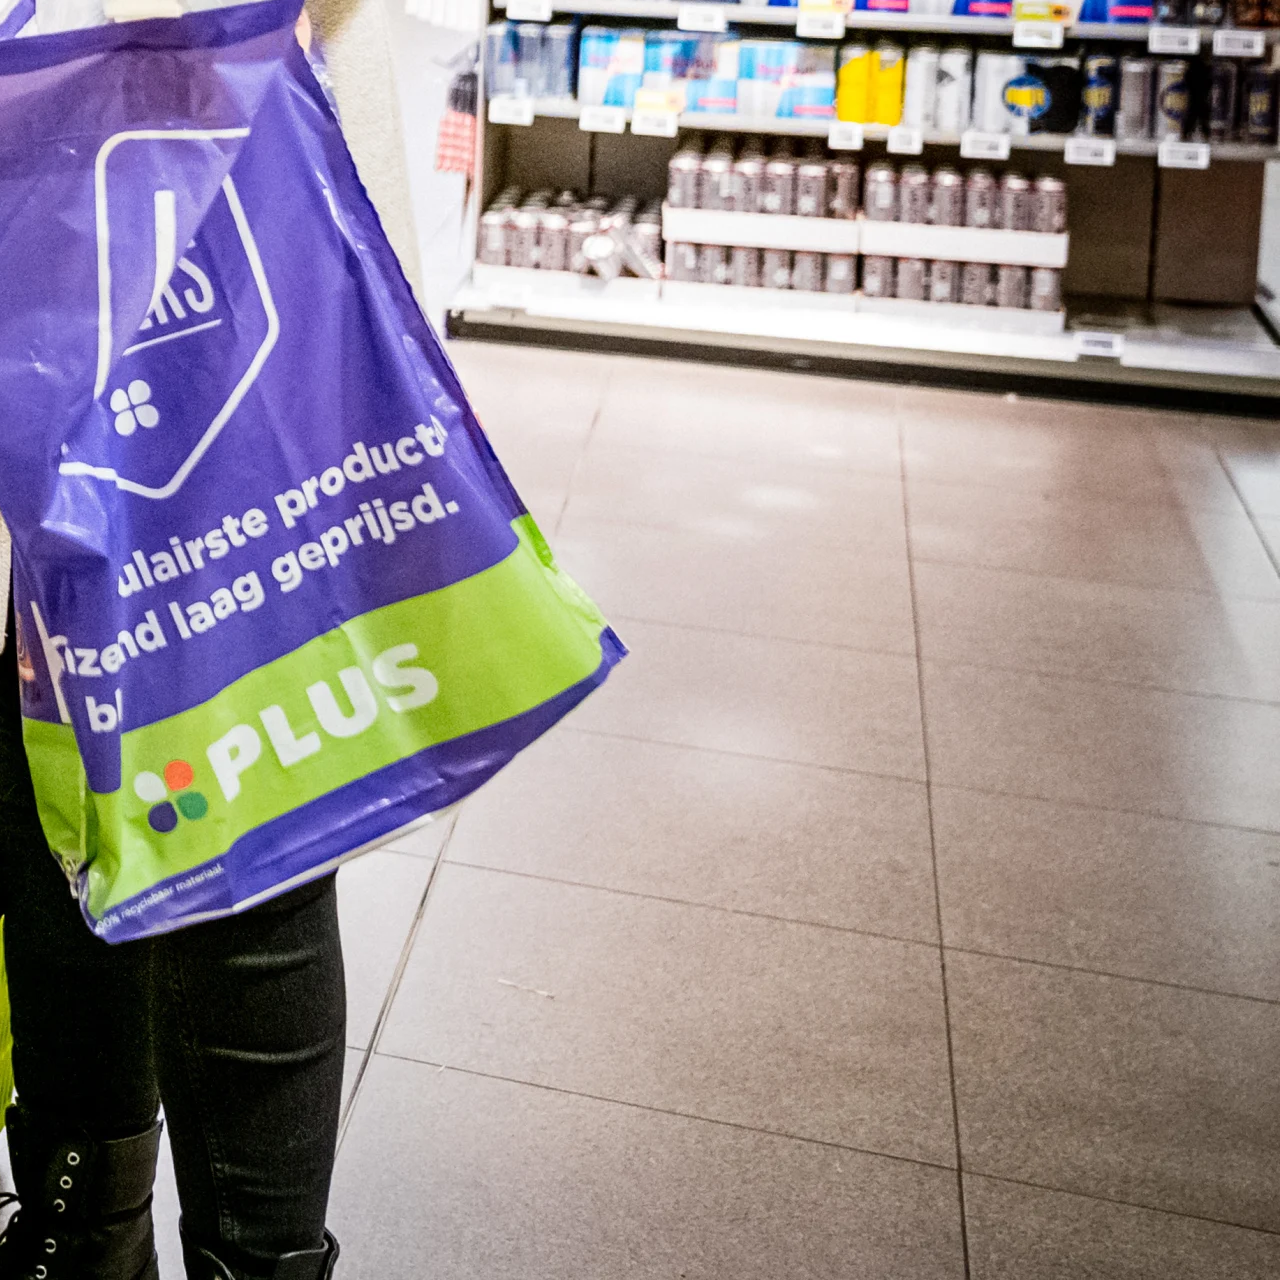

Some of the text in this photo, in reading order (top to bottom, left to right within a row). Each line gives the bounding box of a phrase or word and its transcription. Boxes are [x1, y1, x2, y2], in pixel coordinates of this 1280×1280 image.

[274, 413, 449, 529] product
[168, 570, 267, 641] laag
[270, 482, 460, 593] geprijsd.
[206, 642, 441, 803] PLUS
[121, 884, 175, 919] recyclebaar
